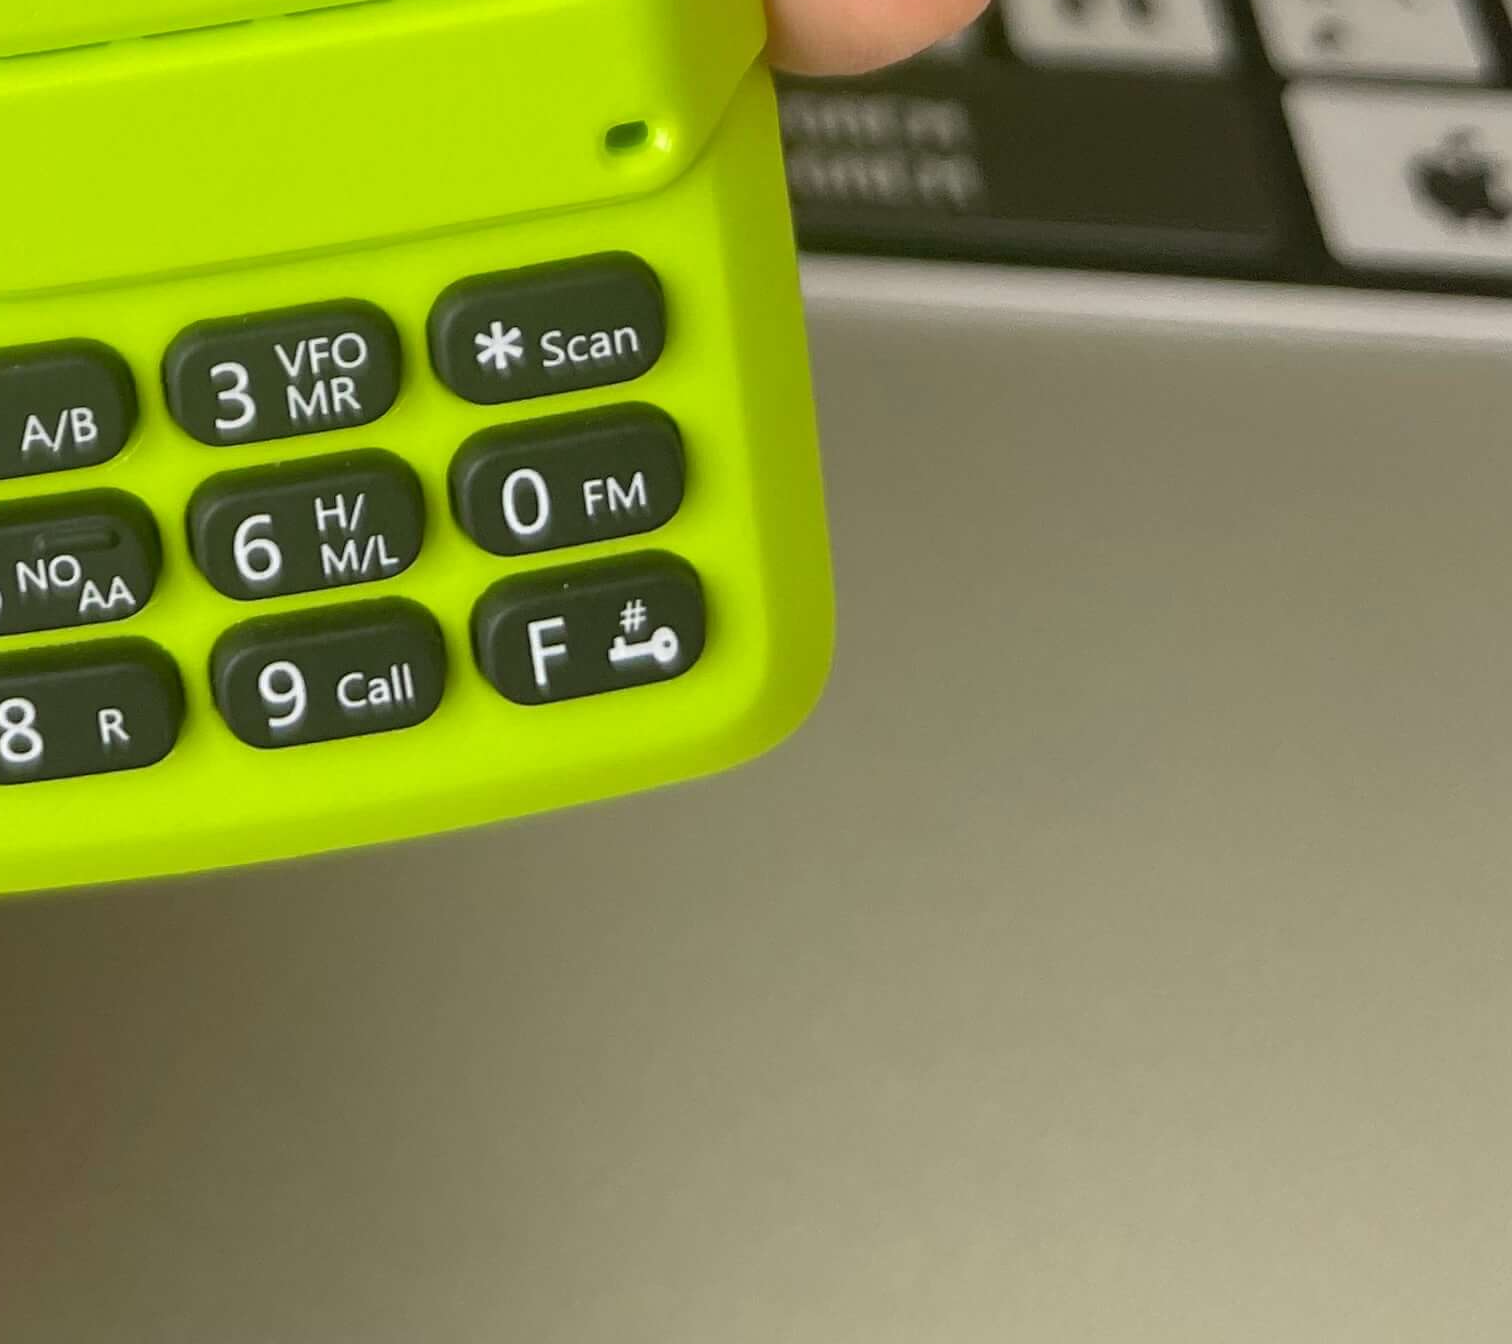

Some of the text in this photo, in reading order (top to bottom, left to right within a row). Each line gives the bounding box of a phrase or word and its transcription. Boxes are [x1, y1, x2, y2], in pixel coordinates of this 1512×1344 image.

[540, 327, 639, 367] Scan
[210, 331, 367, 431] 3 VFO
[287, 376, 362, 420] MR
[21, 407, 98, 453] A/B
[502, 468, 647, 536] 0 FM
[233, 493, 364, 582] 6 H/
[321, 534, 399, 575] M/L
[528, 617, 567, 687] F
[258, 661, 414, 728] 9 Call
[99, 708, 129, 745] R
